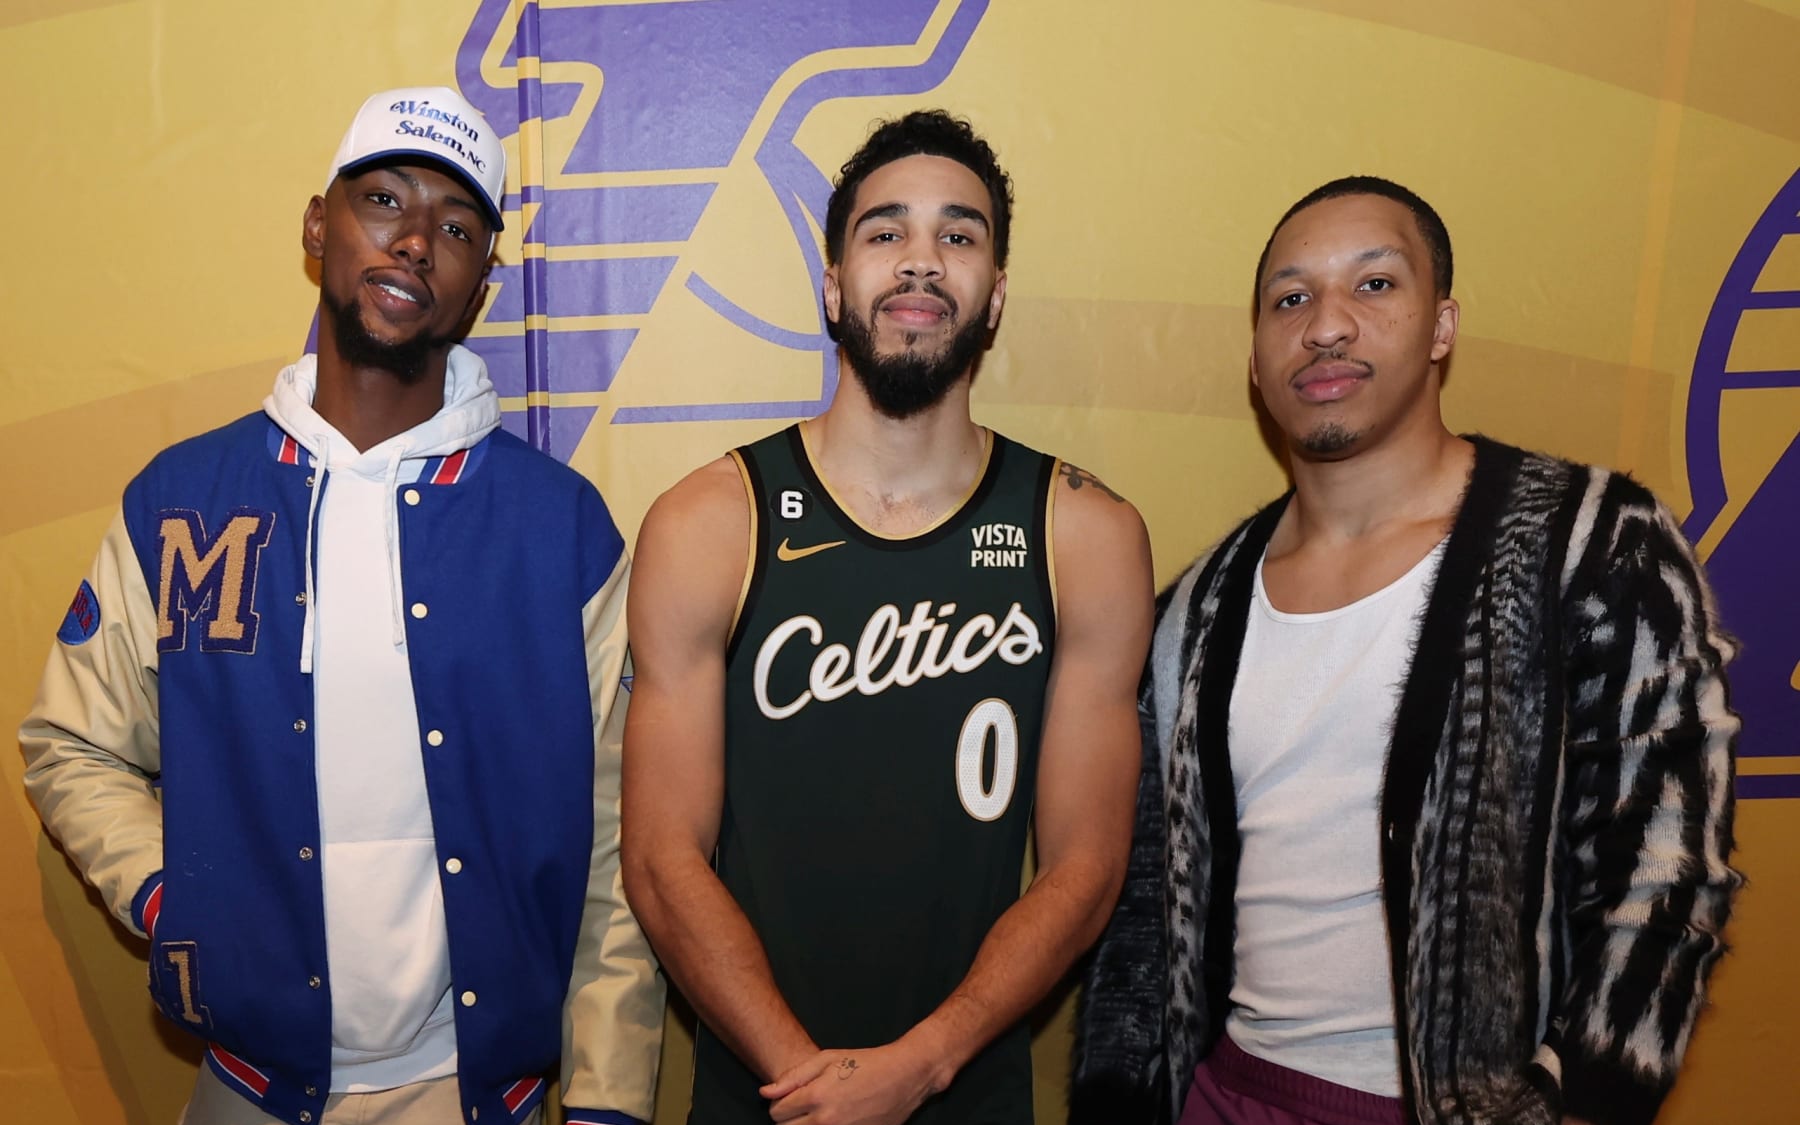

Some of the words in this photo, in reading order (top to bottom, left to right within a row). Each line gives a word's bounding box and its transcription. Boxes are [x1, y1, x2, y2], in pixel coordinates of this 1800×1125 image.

[390, 99, 480, 142] Winston
[395, 119, 466, 158] Salem,
[466, 151, 487, 174] NC
[780, 490, 804, 519] 6
[971, 523, 1028, 550] VISTA
[971, 550, 1028, 568] PRINT
[157, 508, 273, 653] M
[753, 600, 1044, 720] Celtics
[955, 697, 1019, 822] 0
